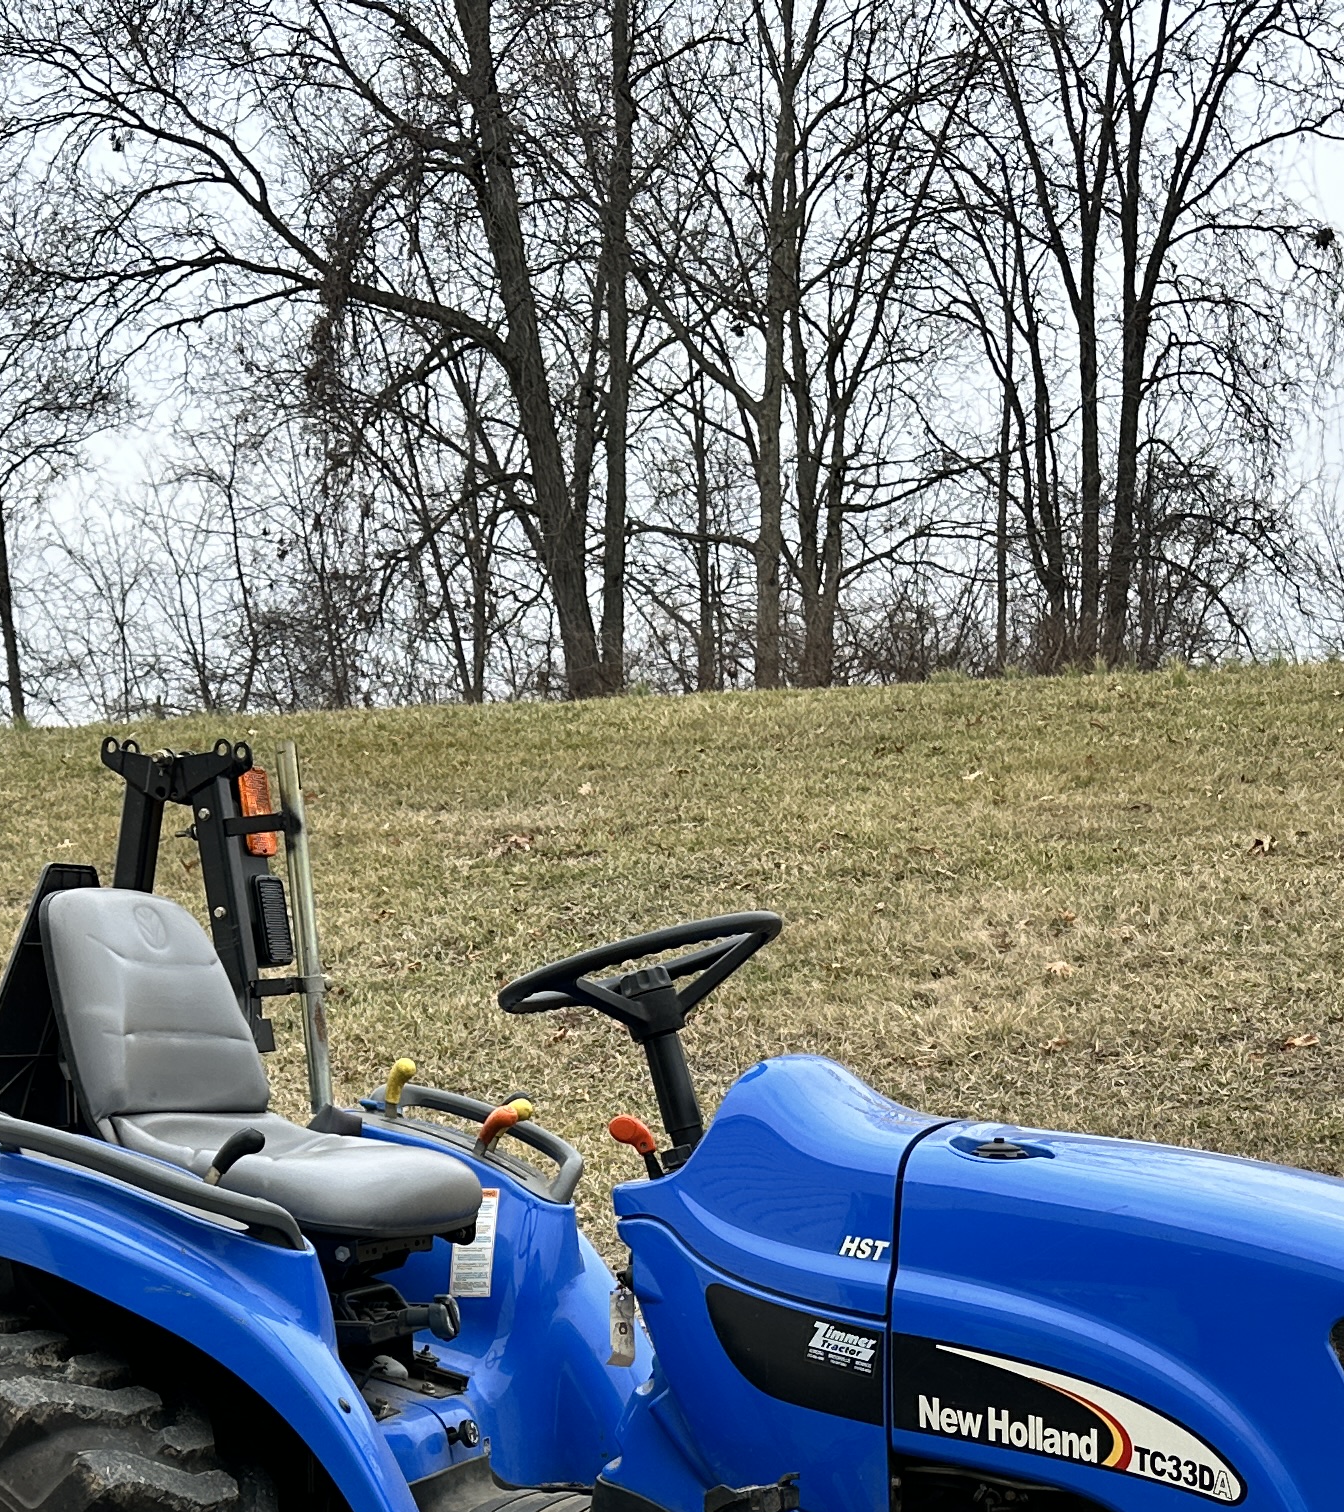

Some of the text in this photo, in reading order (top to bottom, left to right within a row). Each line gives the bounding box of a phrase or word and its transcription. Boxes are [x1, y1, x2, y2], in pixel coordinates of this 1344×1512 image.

[838, 1235, 890, 1261] HST
[808, 1320, 877, 1349] Zimmer
[820, 1339, 863, 1357] Tractor
[918, 1394, 1098, 1464] New Holland
